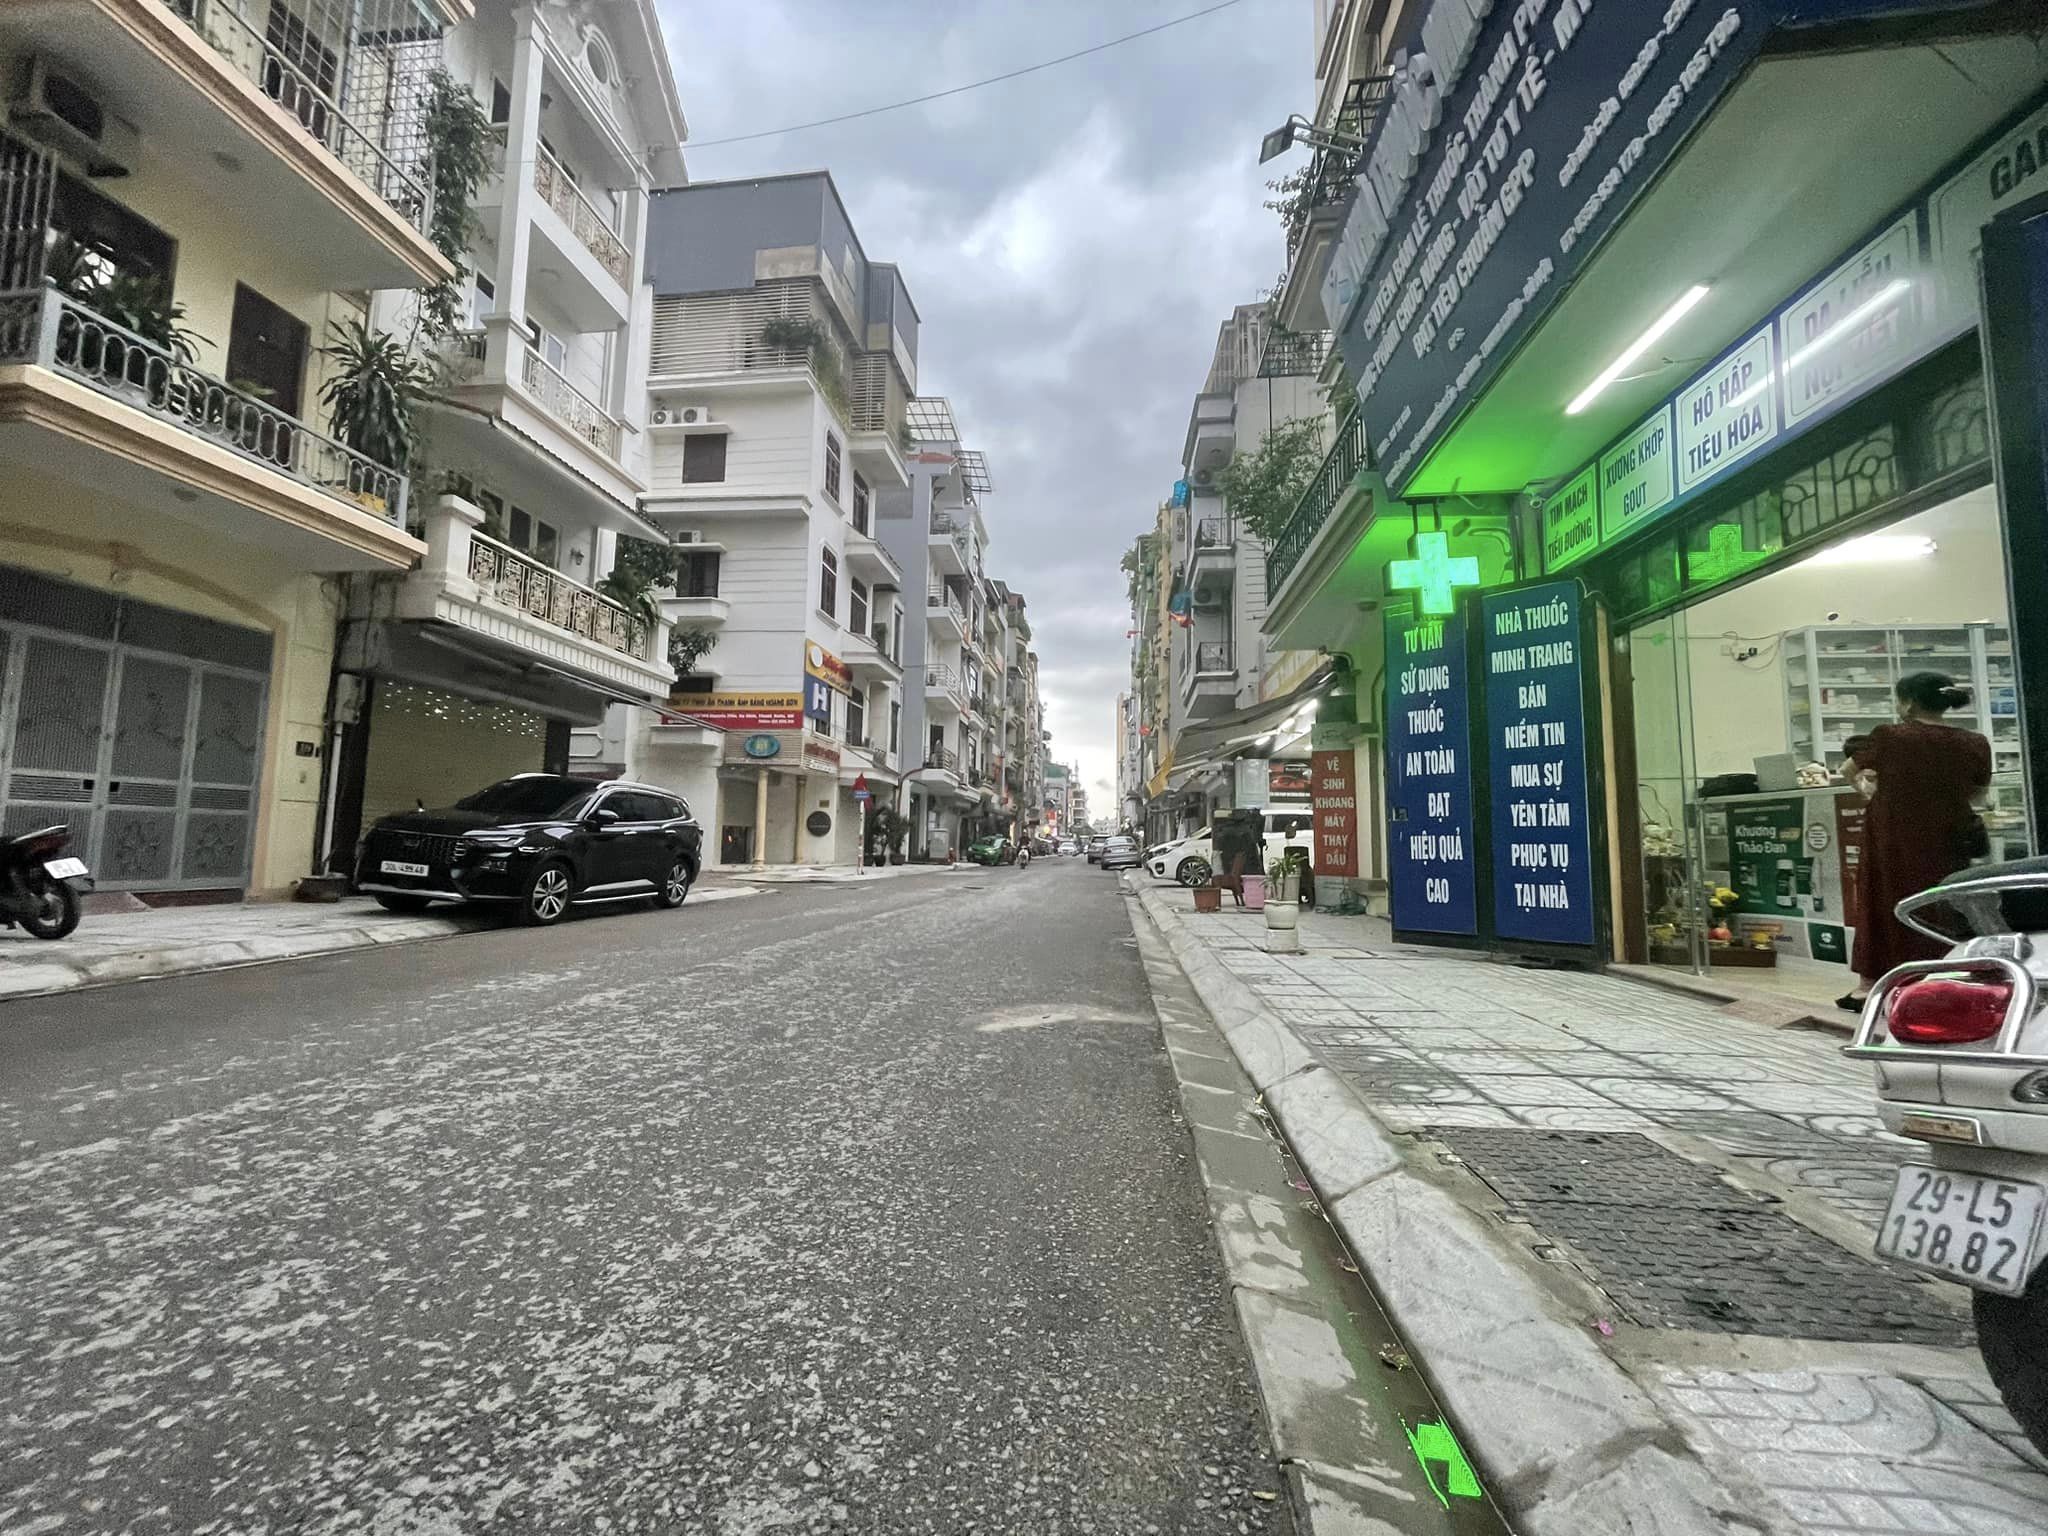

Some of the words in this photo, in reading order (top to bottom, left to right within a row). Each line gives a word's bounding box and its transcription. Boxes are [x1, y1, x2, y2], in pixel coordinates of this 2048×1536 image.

[1503, 97, 1522, 137] Y
[1516, 42, 1548, 112] TẾ
[1426, 131, 1468, 217] THUỐC
[1463, 31, 1519, 141] THÀNH
[1693, 385, 1714, 427] HÔ
[1719, 357, 1753, 408] HẤP
[1688, 430, 1722, 474] TIÊU
[1728, 403, 1764, 451] HÓA
[1605, 454, 1636, 489] XƯƠNG
[1637, 426, 1665, 465] KHỚP
[1550, 501, 1563, 527] TIM
[1565, 482, 1588, 517] MẠCH
[1623, 481, 1647, 517] GOUT
[1495, 605, 1522, 635] NHÀ
[1525, 595, 1569, 631] THUỐC
[1404, 627, 1419, 654] TƯ
[1491, 648, 1526, 674] MINH
[1528, 641, 1573, 669] TRANG
[1401, 663, 1417, 695] SỬ
[1419, 665, 1449, 696] DỤNG
[1519, 680, 1547, 709] BÁN
[812, 683, 828, 712] H
[1407, 700, 1444, 735] THUỐC
[1542, 721, 1566, 746] TIN
[1327, 756, 1340, 773] VỆ
[1406, 751, 1422, 777] AN
[1424, 745, 1455, 775] TOÀN
[1511, 763, 1540, 788] MUA
[1543, 760, 1564, 791] SỰ
[1322, 778, 1345, 790] SINH
[1315, 796, 1354, 809] KHOANG
[1428, 792, 1451, 823] ĐẠT
[1511, 799, 1537, 827] YÊN
[1540, 798, 1570, 827] TÂM
[1322, 834, 1348, 847] THAY
[1410, 829, 1436, 866] HIỆU
[1438, 826, 1464, 864] QUẢ
[1764, 841, 1787, 854] Đan
[1511, 843, 1547, 873] PHỤC
[1550, 843, 1569, 873] VỤ
[1426, 878, 1450, 904] CAO
[1514, 884, 1536, 913] TẠI
[1539, 879, 1569, 910] NHÀ
[1907, 1172, 2018, 1229] 29-L5
[1891, 1214, 2017, 1284] 138.82
